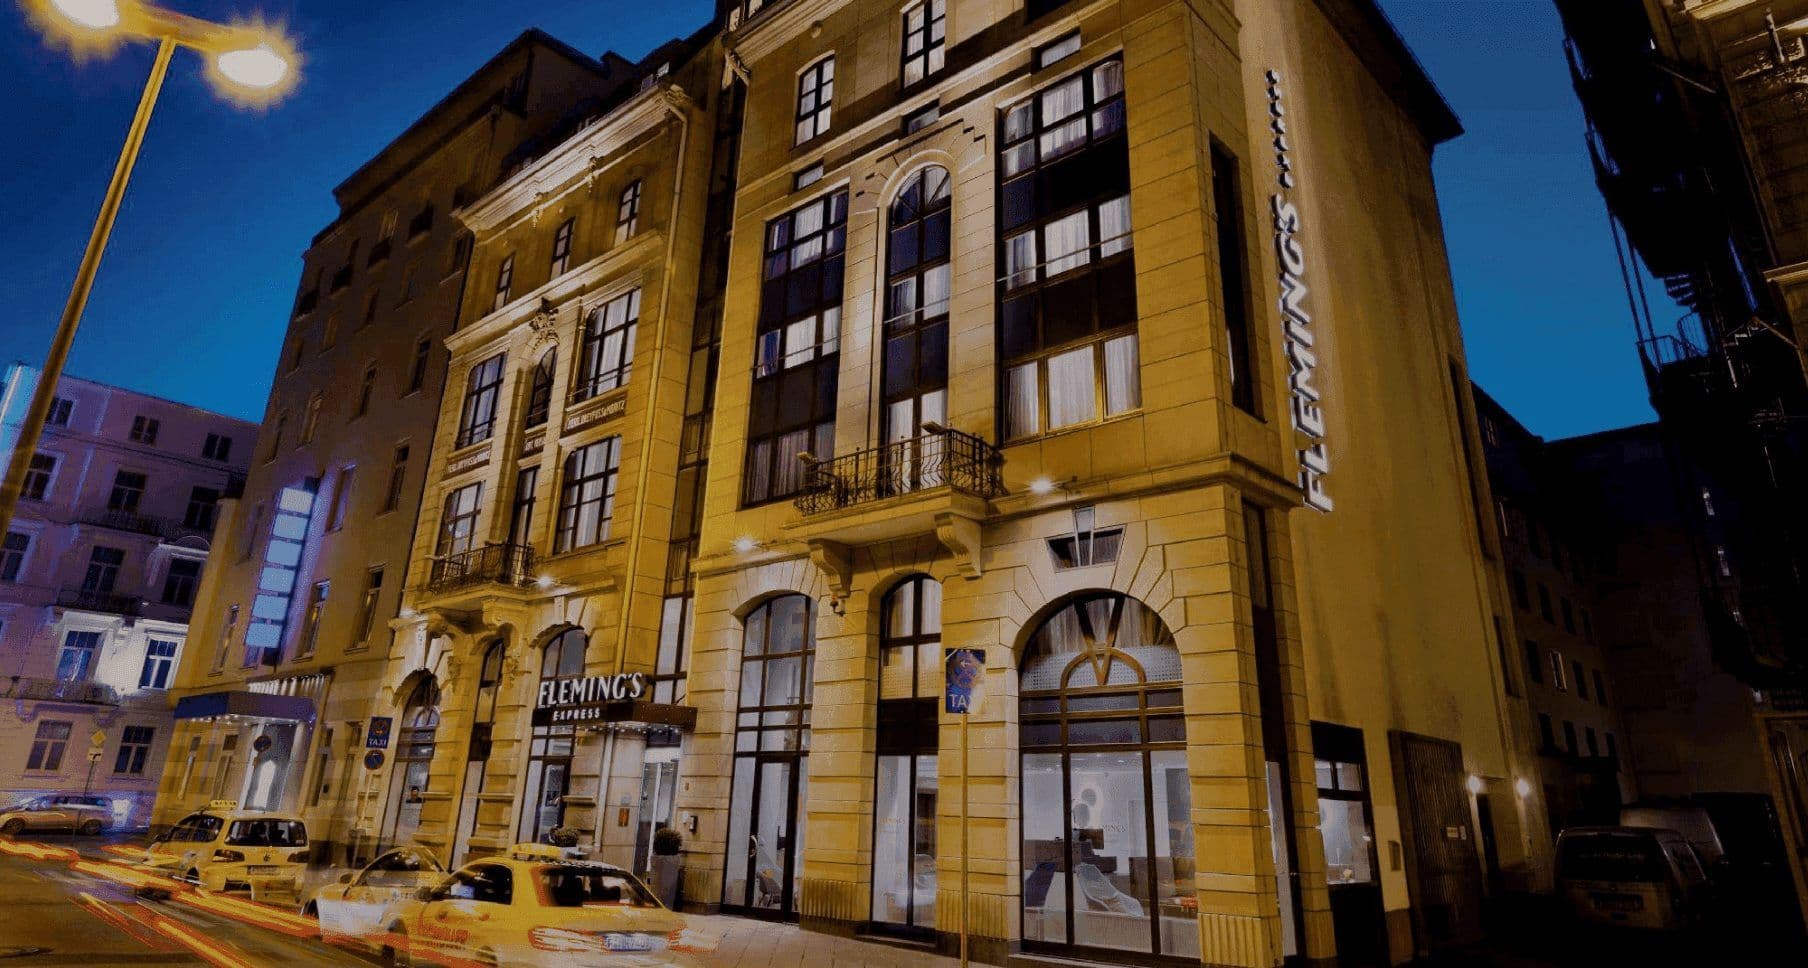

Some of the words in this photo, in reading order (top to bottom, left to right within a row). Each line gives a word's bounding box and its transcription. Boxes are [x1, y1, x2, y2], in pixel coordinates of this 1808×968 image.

[538, 672, 642, 708] FLEMING'S
[552, 707, 601, 721] EXPRESS
[369, 738, 388, 746] TAXI
